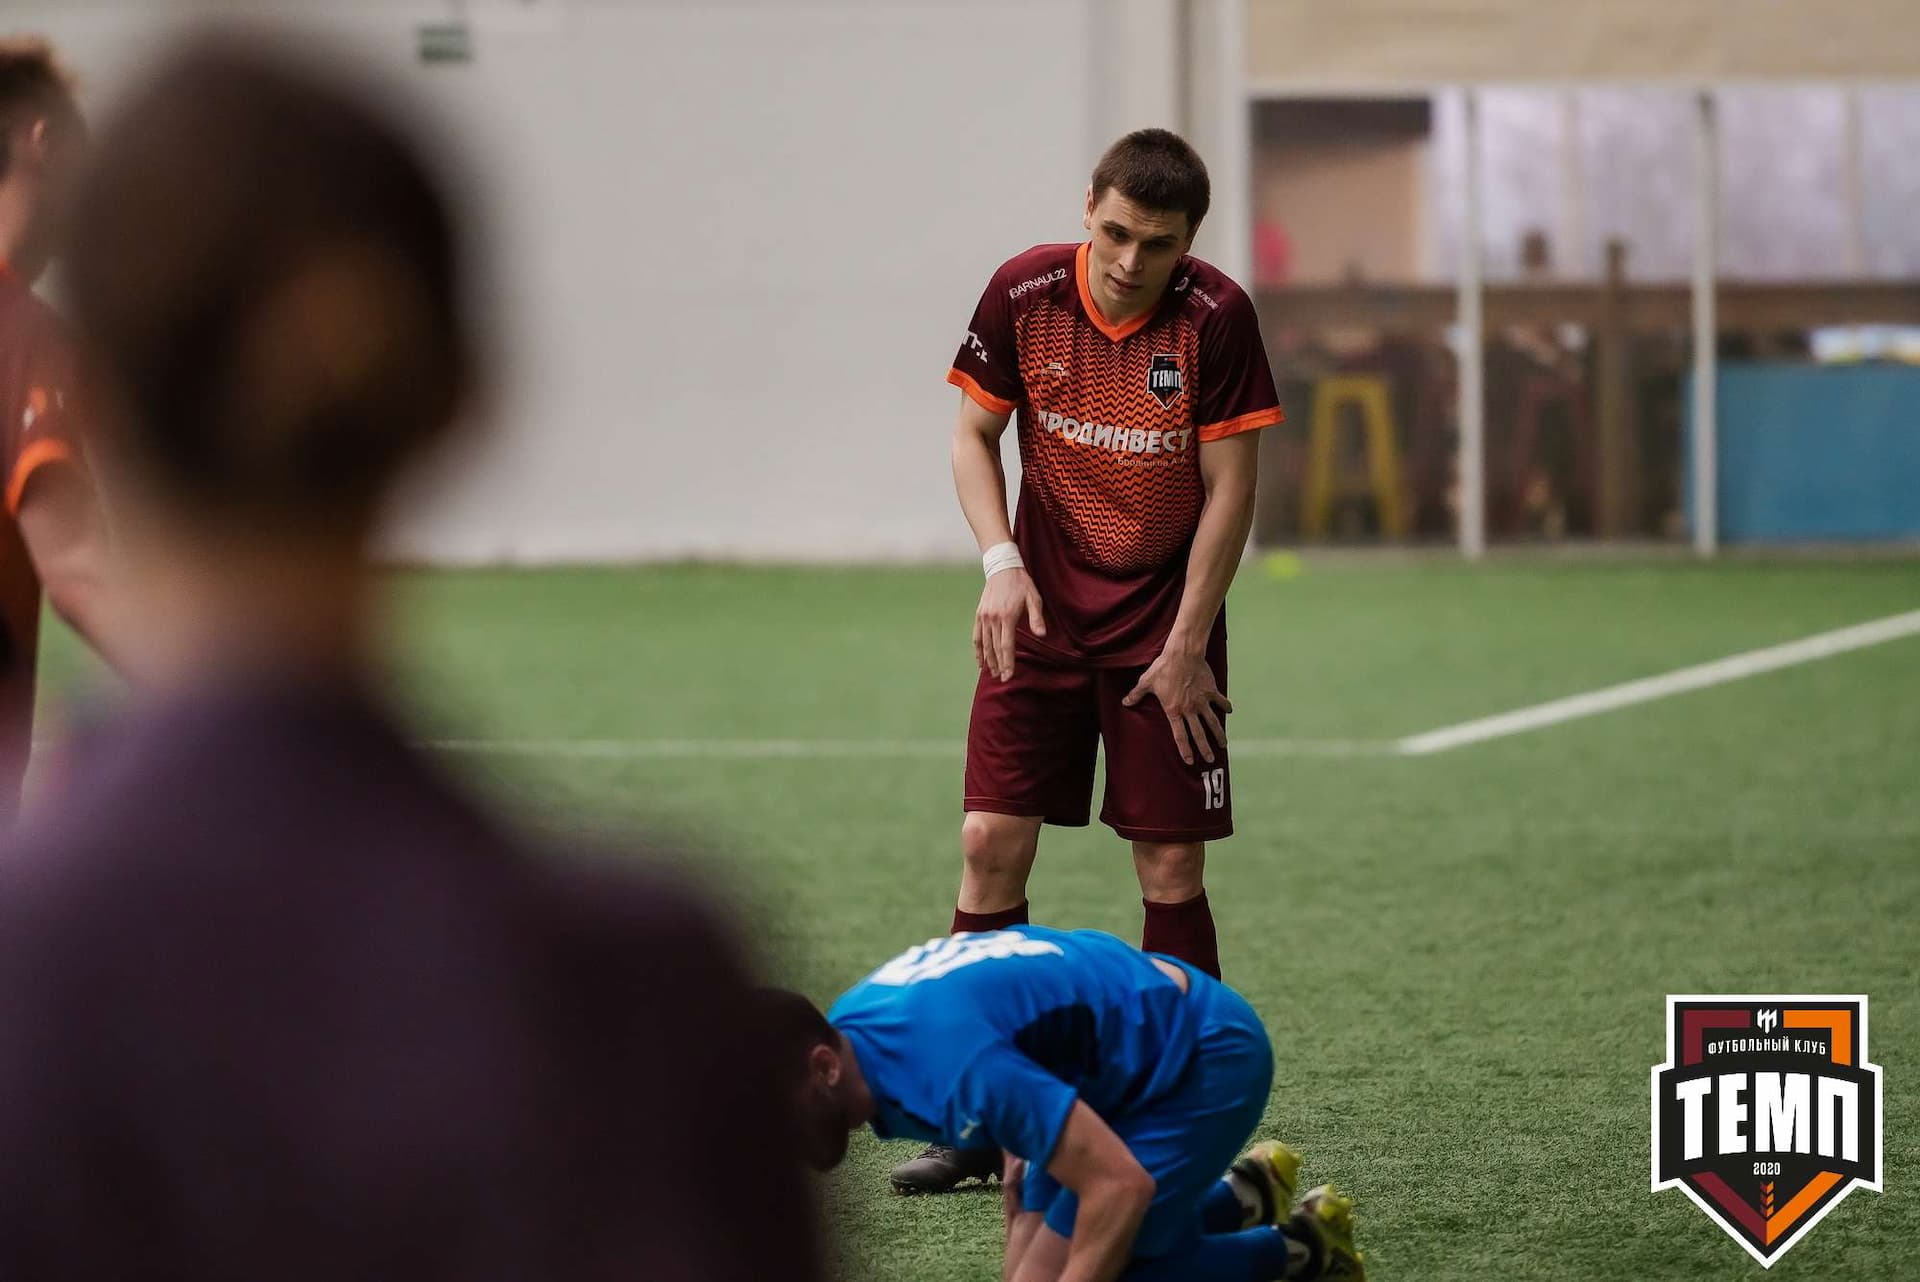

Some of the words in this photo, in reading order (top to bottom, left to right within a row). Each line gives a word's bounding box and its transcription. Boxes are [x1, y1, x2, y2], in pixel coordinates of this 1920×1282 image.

[1009, 268, 1067, 300] BARNAUL22
[1152, 370, 1182, 389] ТЕМП
[1201, 768, 1225, 810] 19
